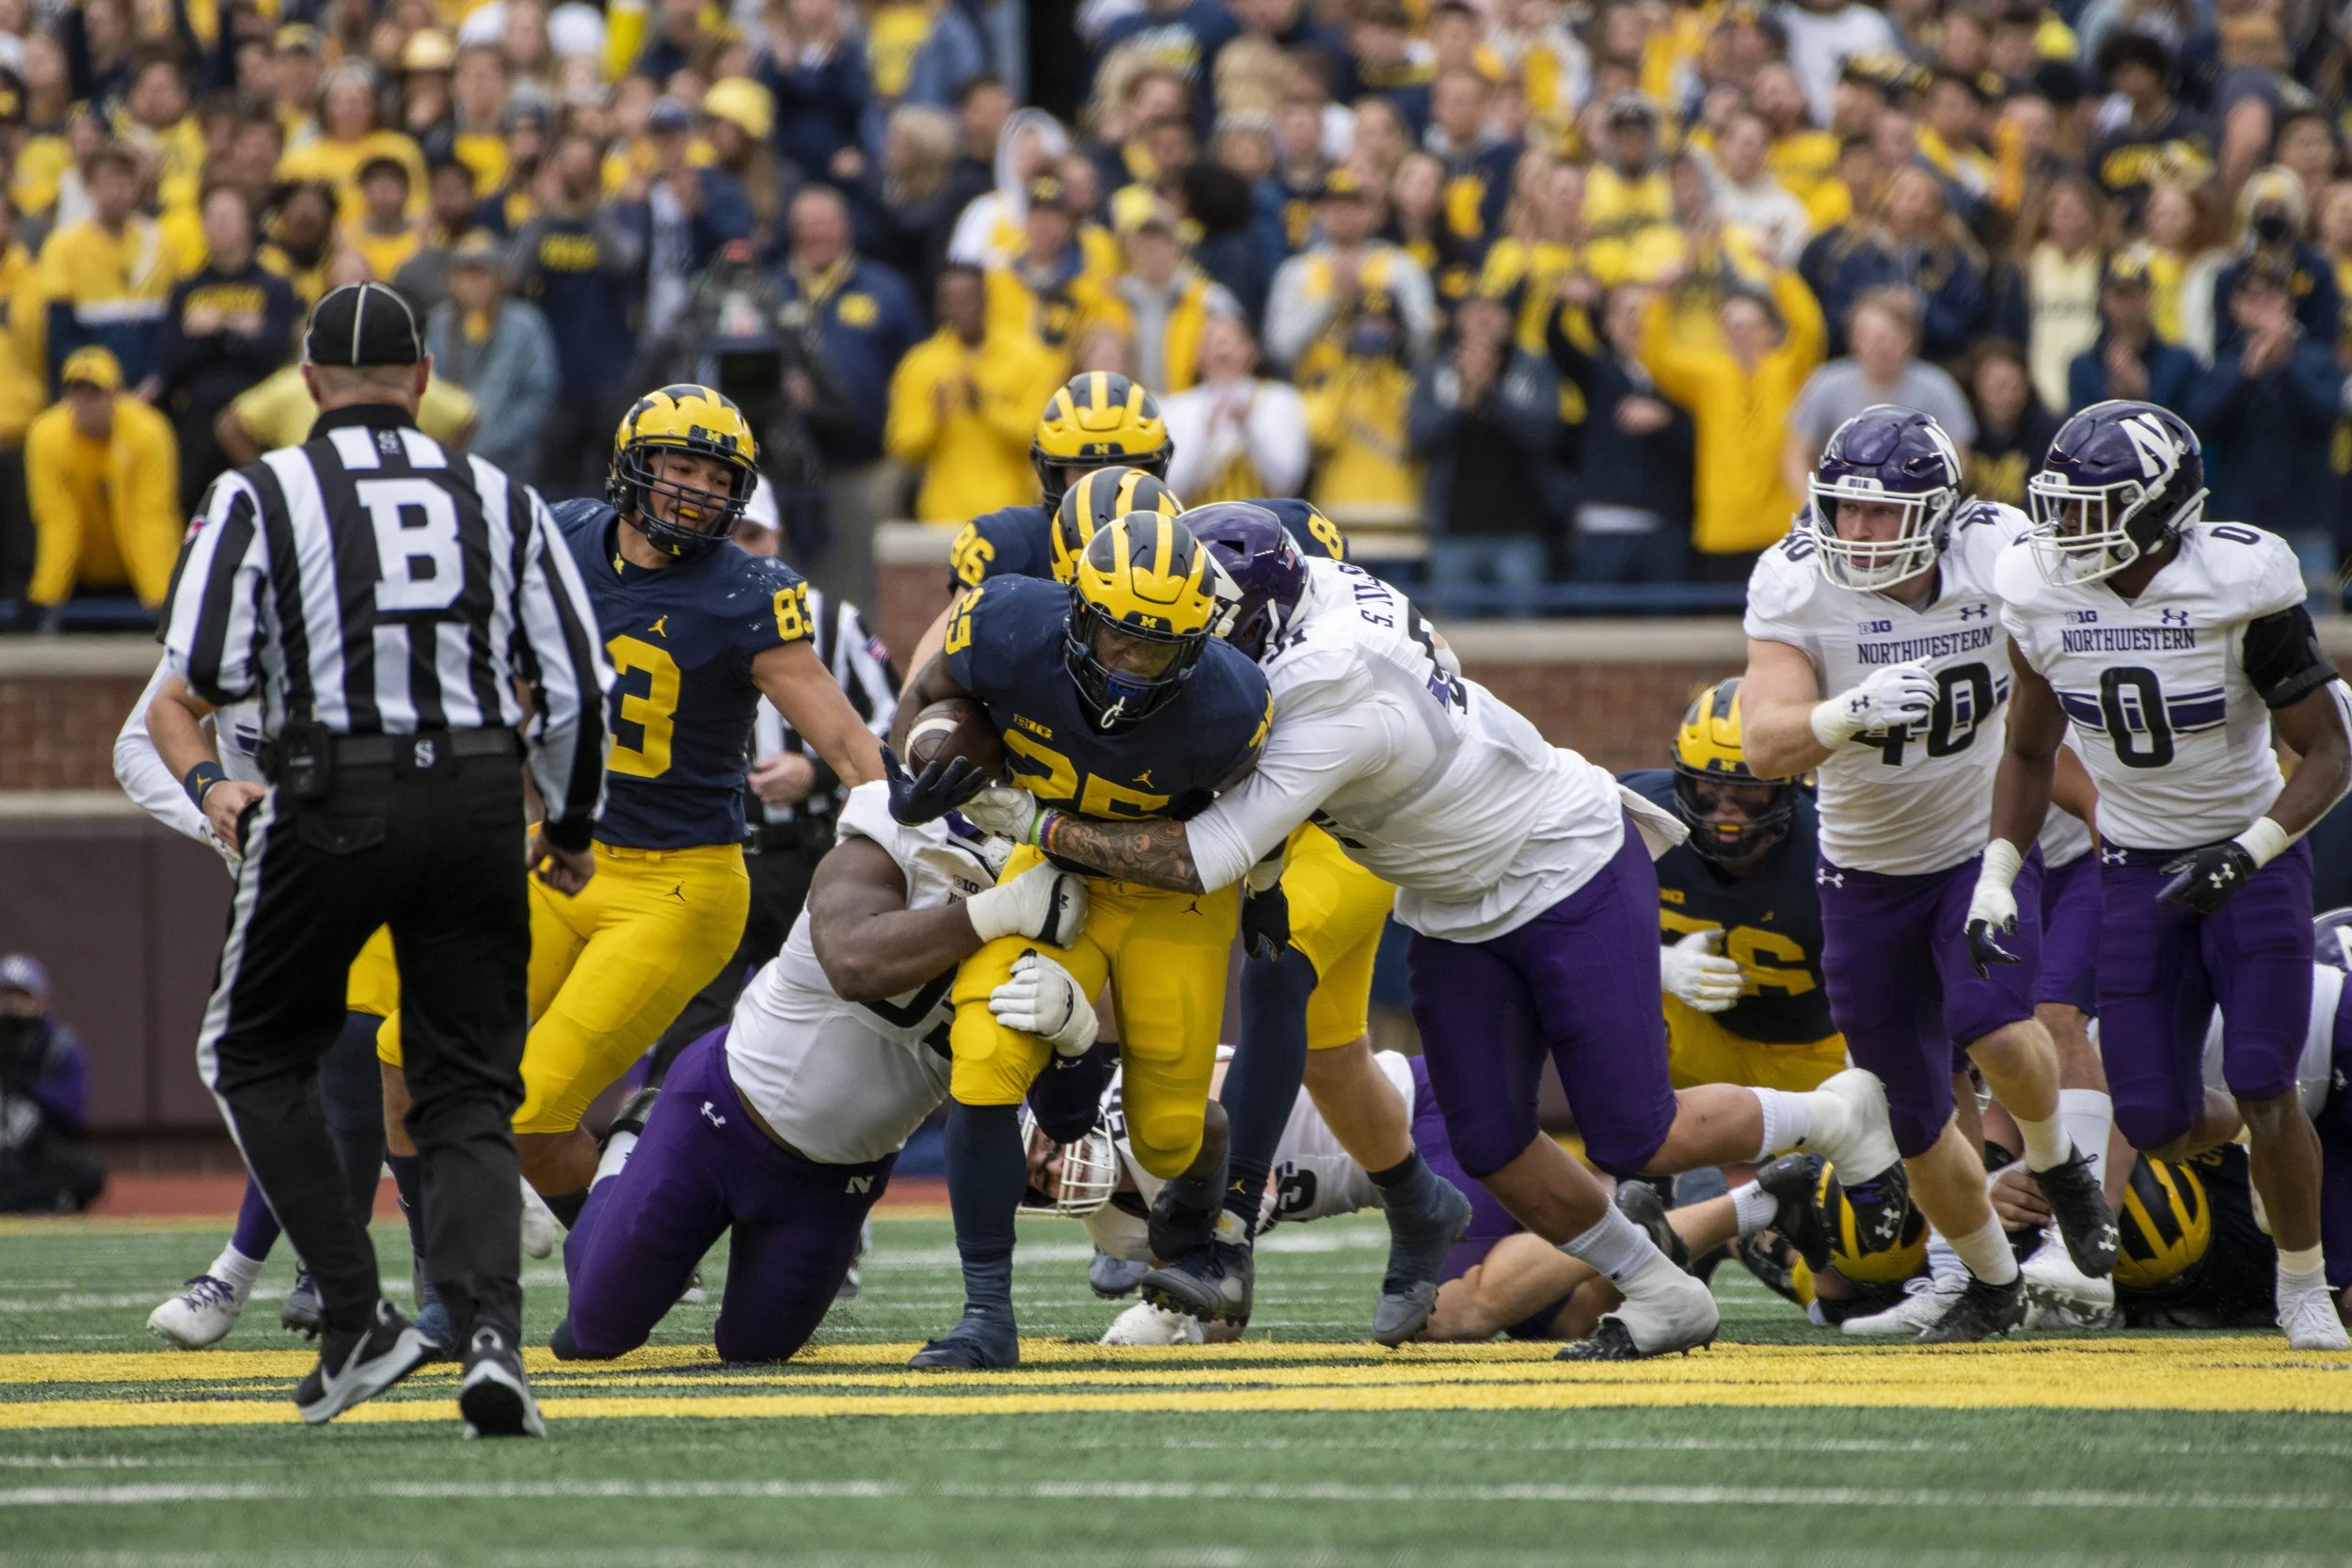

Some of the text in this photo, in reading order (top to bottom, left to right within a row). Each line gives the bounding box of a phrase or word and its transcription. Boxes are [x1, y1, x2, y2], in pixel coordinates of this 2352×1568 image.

[707, 429, 722, 443] M
[2120, 413, 2181, 478] N
[355, 479, 465, 610] B
[950, 521, 994, 587] 86
[772, 580, 815, 641] 83
[1139, 616, 1157, 628] M
[2061, 627, 2197, 653] NORTHWESTERN
[1857, 626, 1994, 664] NORTHWESTERN
[604, 634, 681, 779] 3
[2100, 666, 2175, 769] 0
[845, 1176, 874, 1194] N
